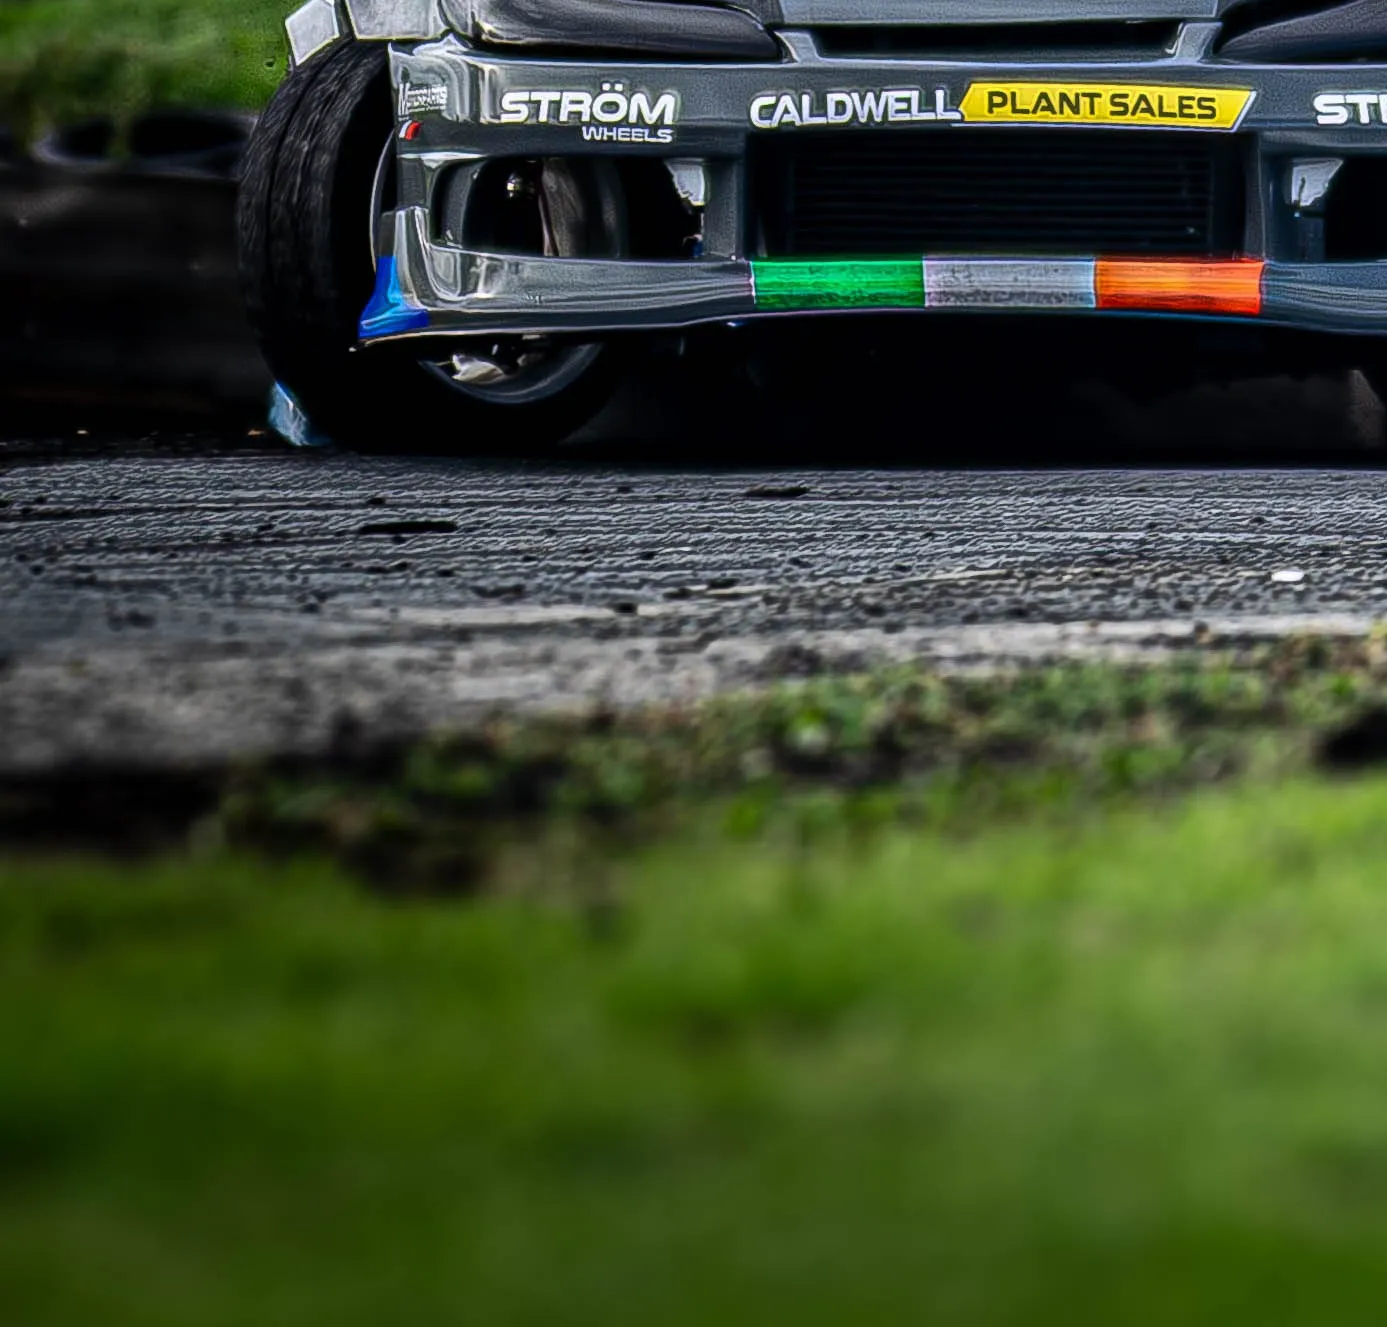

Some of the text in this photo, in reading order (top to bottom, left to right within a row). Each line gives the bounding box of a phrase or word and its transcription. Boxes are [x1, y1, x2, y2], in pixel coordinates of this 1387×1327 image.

[500, 82, 676, 124] STRÖM
[750, 89, 1218, 129] CALDWELL PLANT SALES
[582, 126, 674, 144] WHEELS
